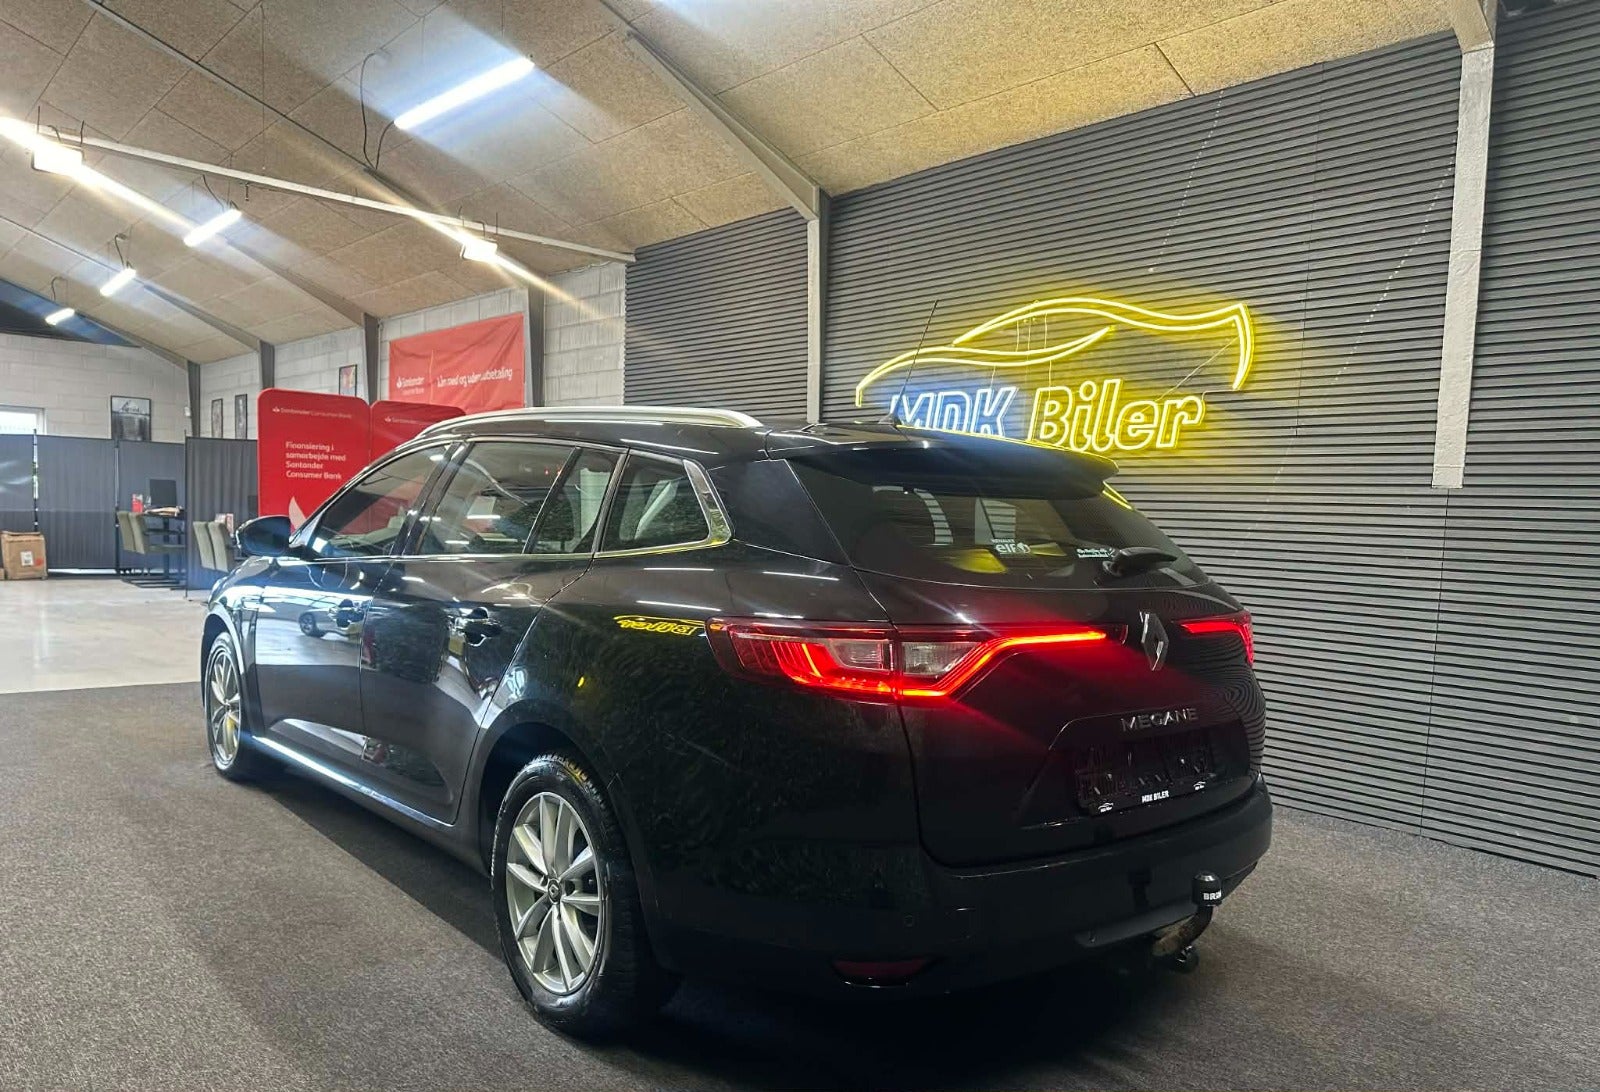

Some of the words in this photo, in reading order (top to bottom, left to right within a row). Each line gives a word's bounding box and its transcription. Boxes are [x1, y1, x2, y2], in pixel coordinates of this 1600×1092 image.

[459, 374, 468, 388] og
[889, 386, 1019, 438] MDK
[1027, 378, 1206, 452] Biler
[285, 441, 330, 452] Finansiering
[285, 452, 329, 461] samarbejde
[330, 454, 346, 462] med
[285, 460, 324, 469] Santander
[285, 470, 323, 479] Consumer
[323, 471, 342, 480] Bank
[1120, 708, 1200, 732] MEGANE
[1153, 790, 1170, 801] BILER
